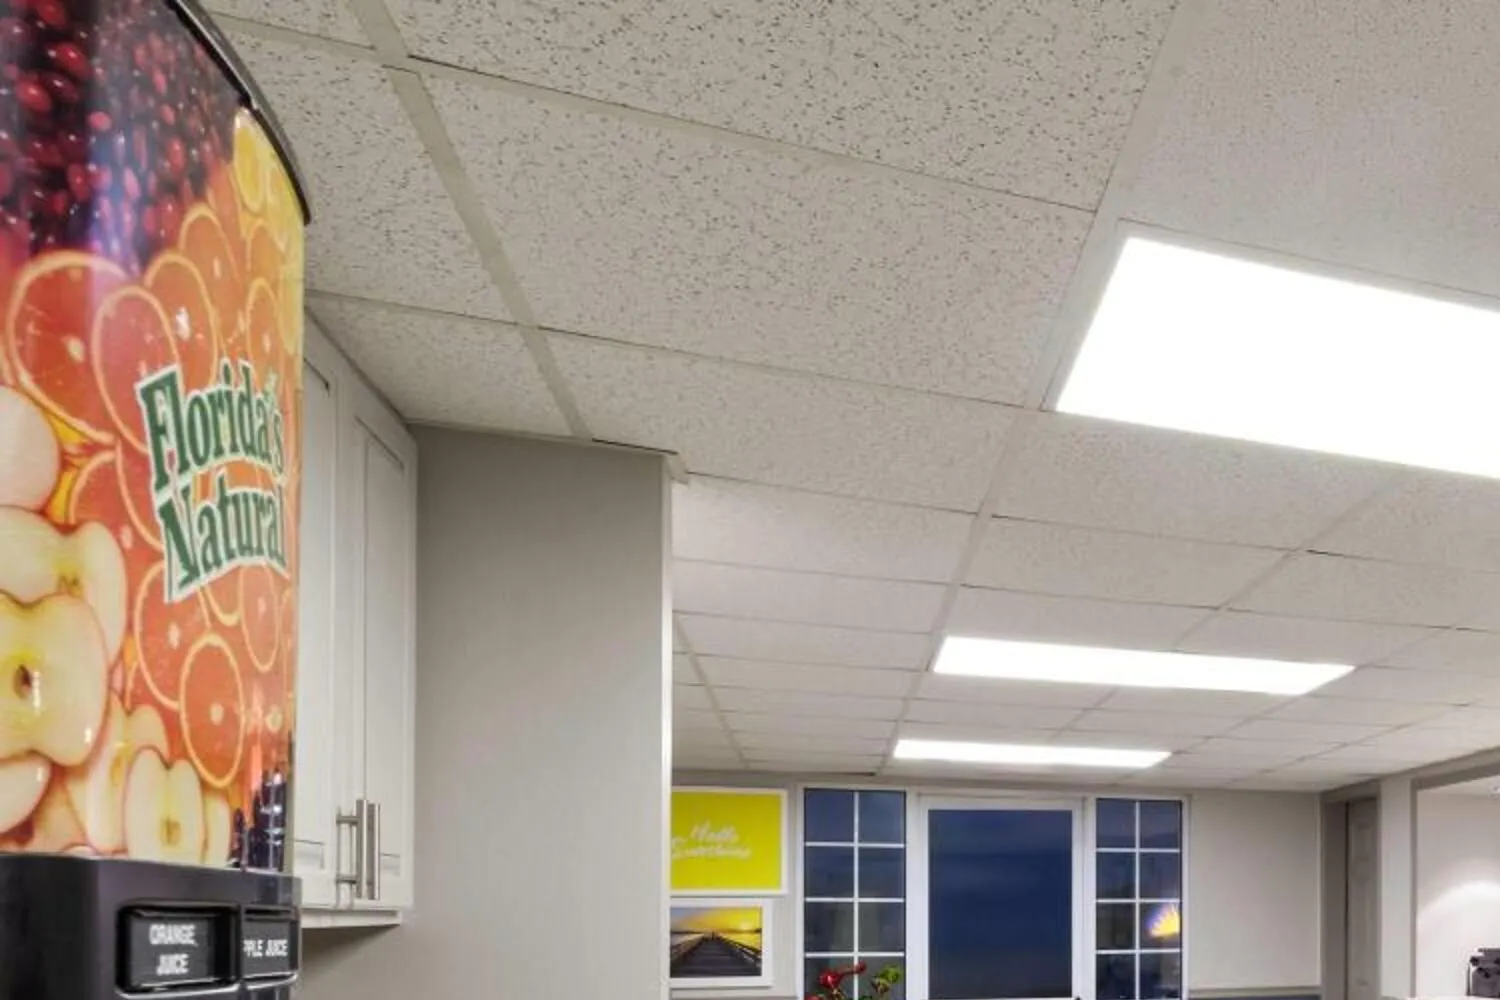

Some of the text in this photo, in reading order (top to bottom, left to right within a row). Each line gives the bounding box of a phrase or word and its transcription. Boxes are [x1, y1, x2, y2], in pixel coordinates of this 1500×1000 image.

[138, 358, 286, 495] Florida's
[157, 473, 288, 600] Natural
[149, 923, 197, 946] ORANGE
[265, 938, 288, 957] JUICE
[156, 953, 190, 976] JUICE
